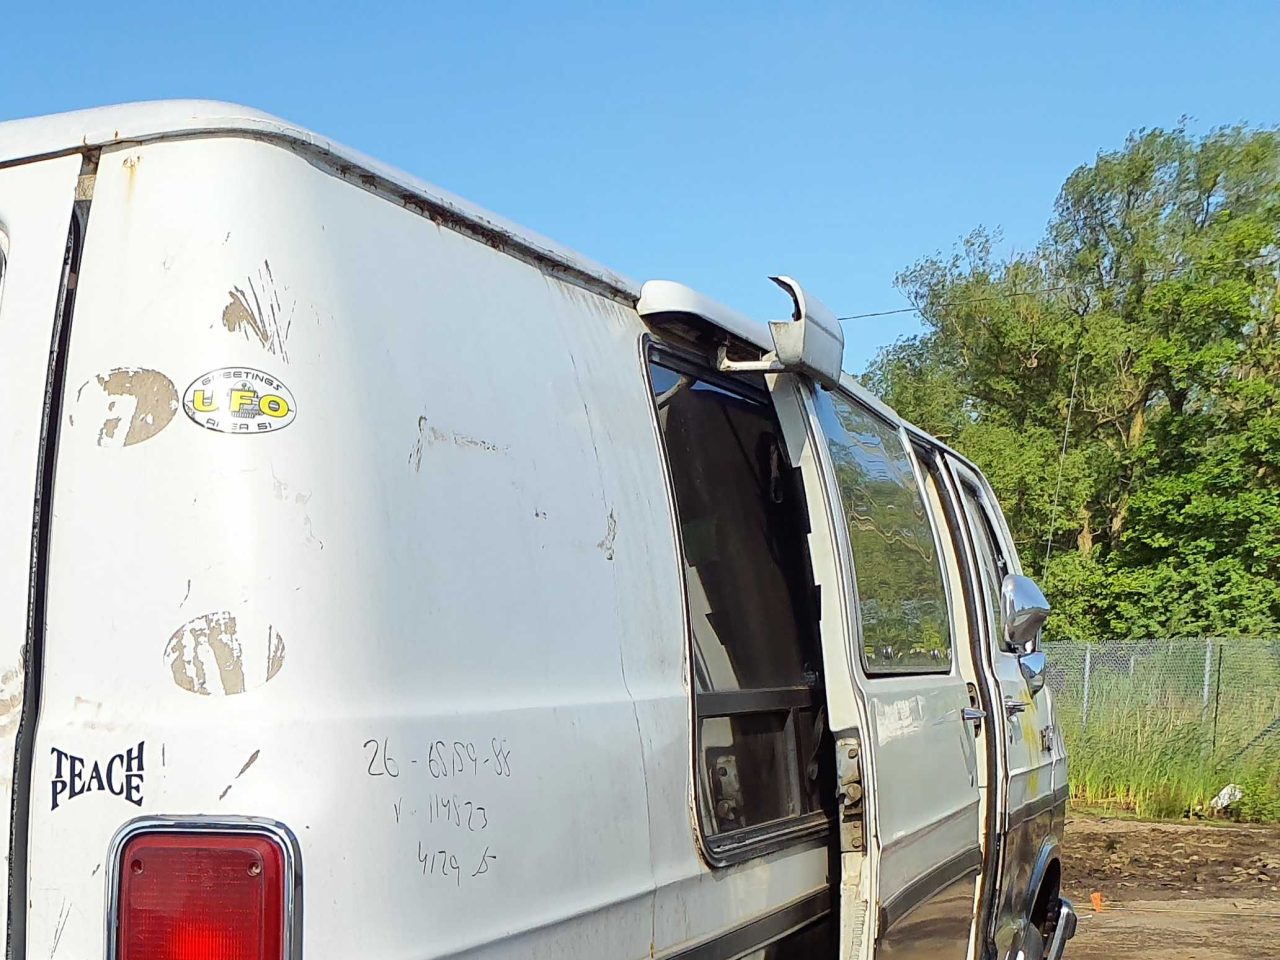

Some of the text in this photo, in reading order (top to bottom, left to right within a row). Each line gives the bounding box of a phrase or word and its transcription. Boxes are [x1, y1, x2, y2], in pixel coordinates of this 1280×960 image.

[202, 371, 282, 391] GEETINGS
[193, 389, 289, 418] UFO
[206, 418, 249, 431] AEA
